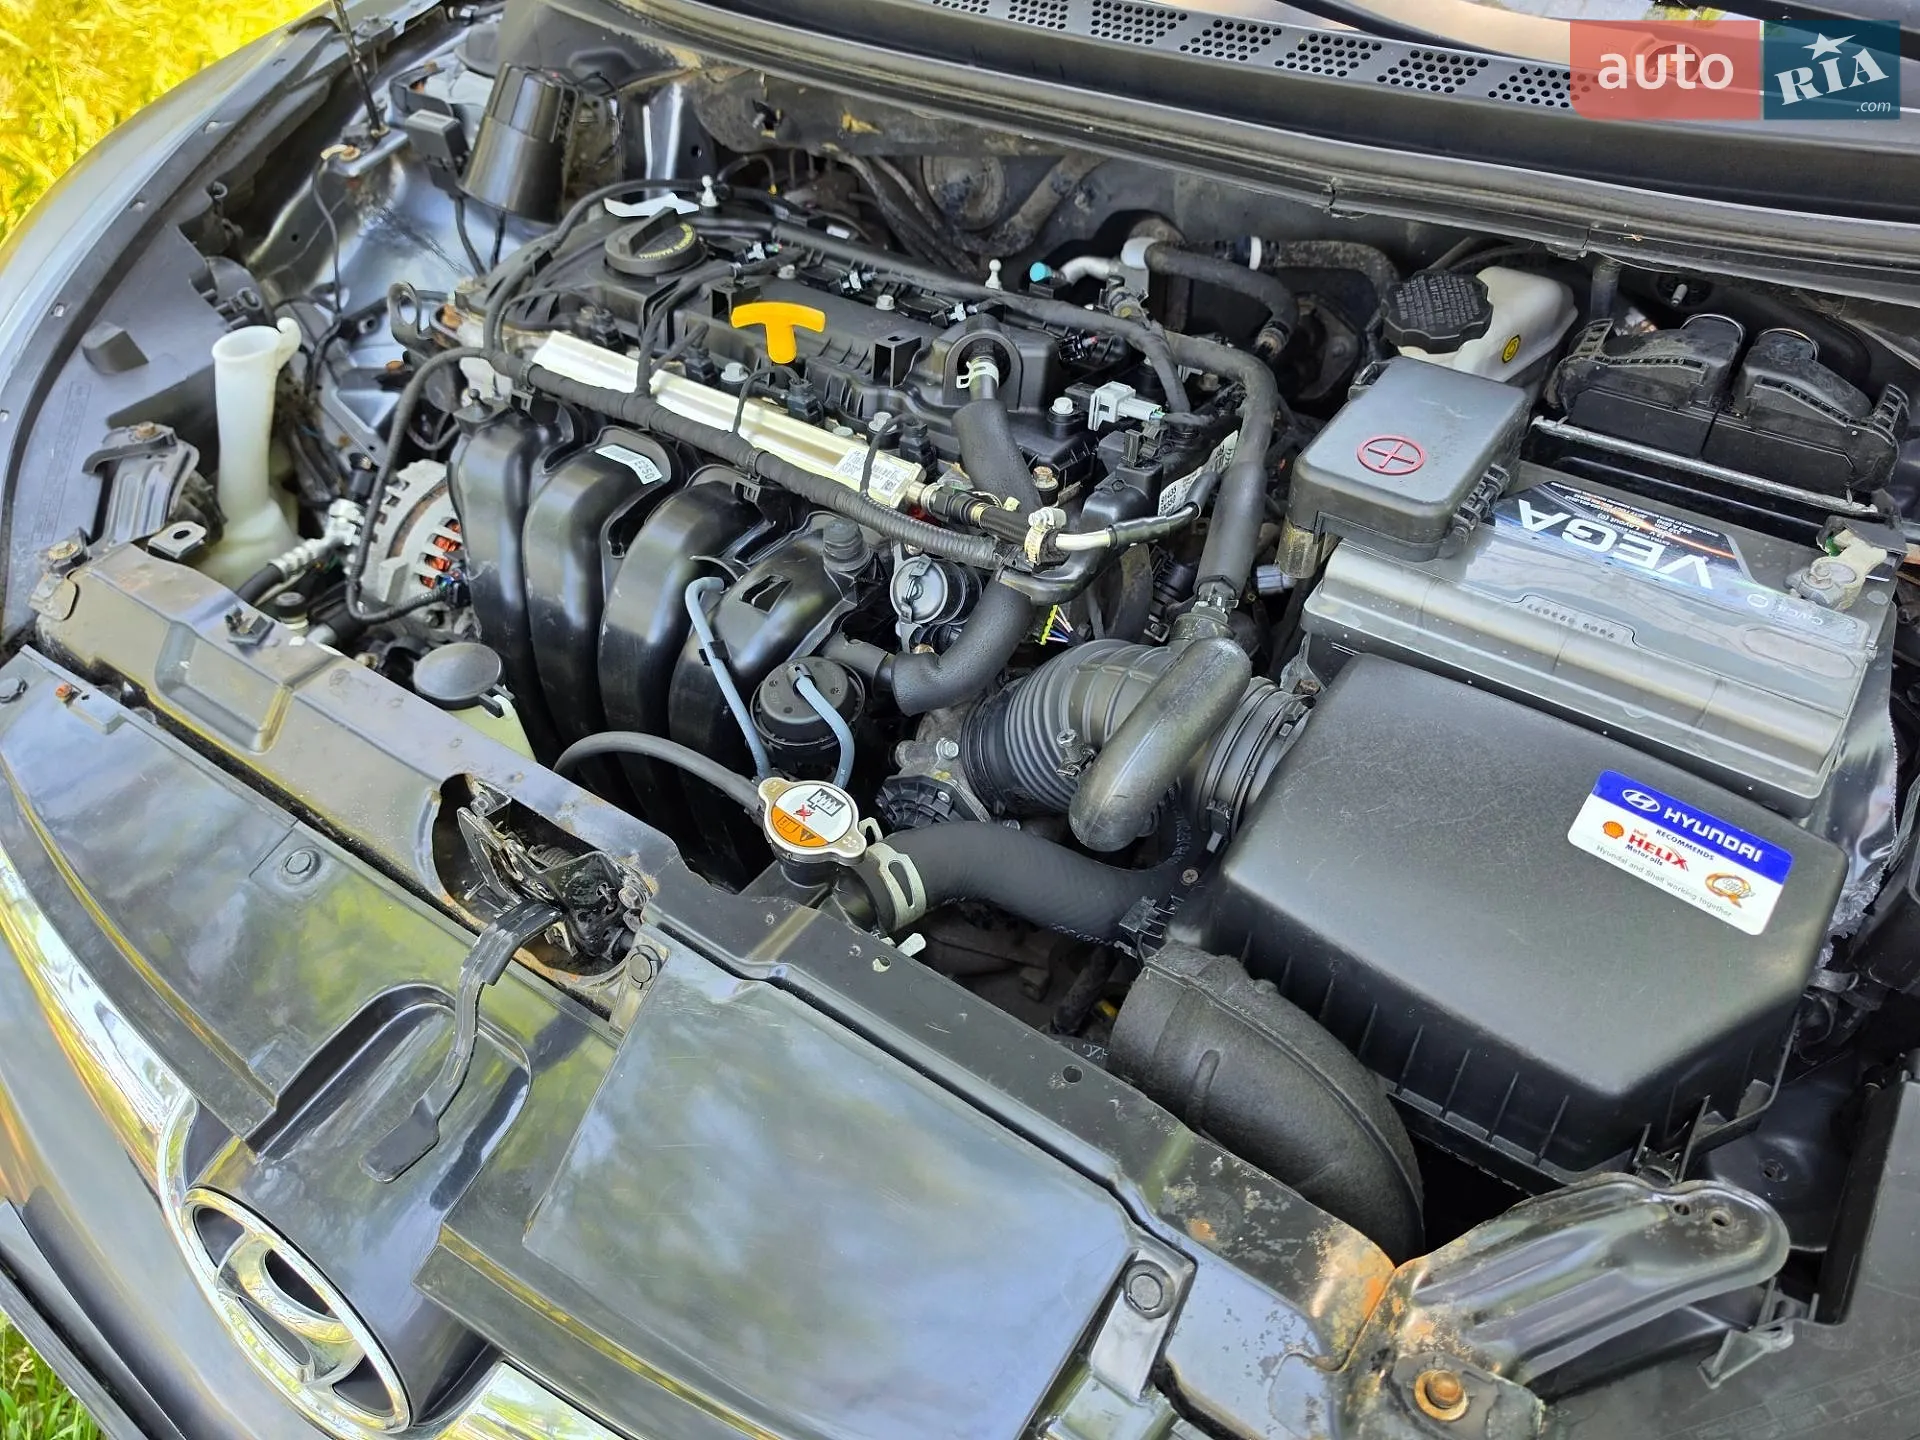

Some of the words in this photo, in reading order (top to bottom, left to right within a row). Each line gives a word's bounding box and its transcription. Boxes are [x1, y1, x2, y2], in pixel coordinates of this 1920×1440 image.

[1518, 498, 1713, 590] VEGA
[1625, 844, 1649, 860] Motor
[1649, 854, 1663, 866] oils
[1628, 834, 1688, 871] HELIX
[1655, 829, 1715, 861] RECOMMENDS
[1663, 807, 1763, 863] HYUNDAI
[1596, 845, 1628, 865] Hyundai
[1629, 860, 1644, 873] and
[1666, 881, 1697, 901] working
[1699, 897, 1732, 918] together
